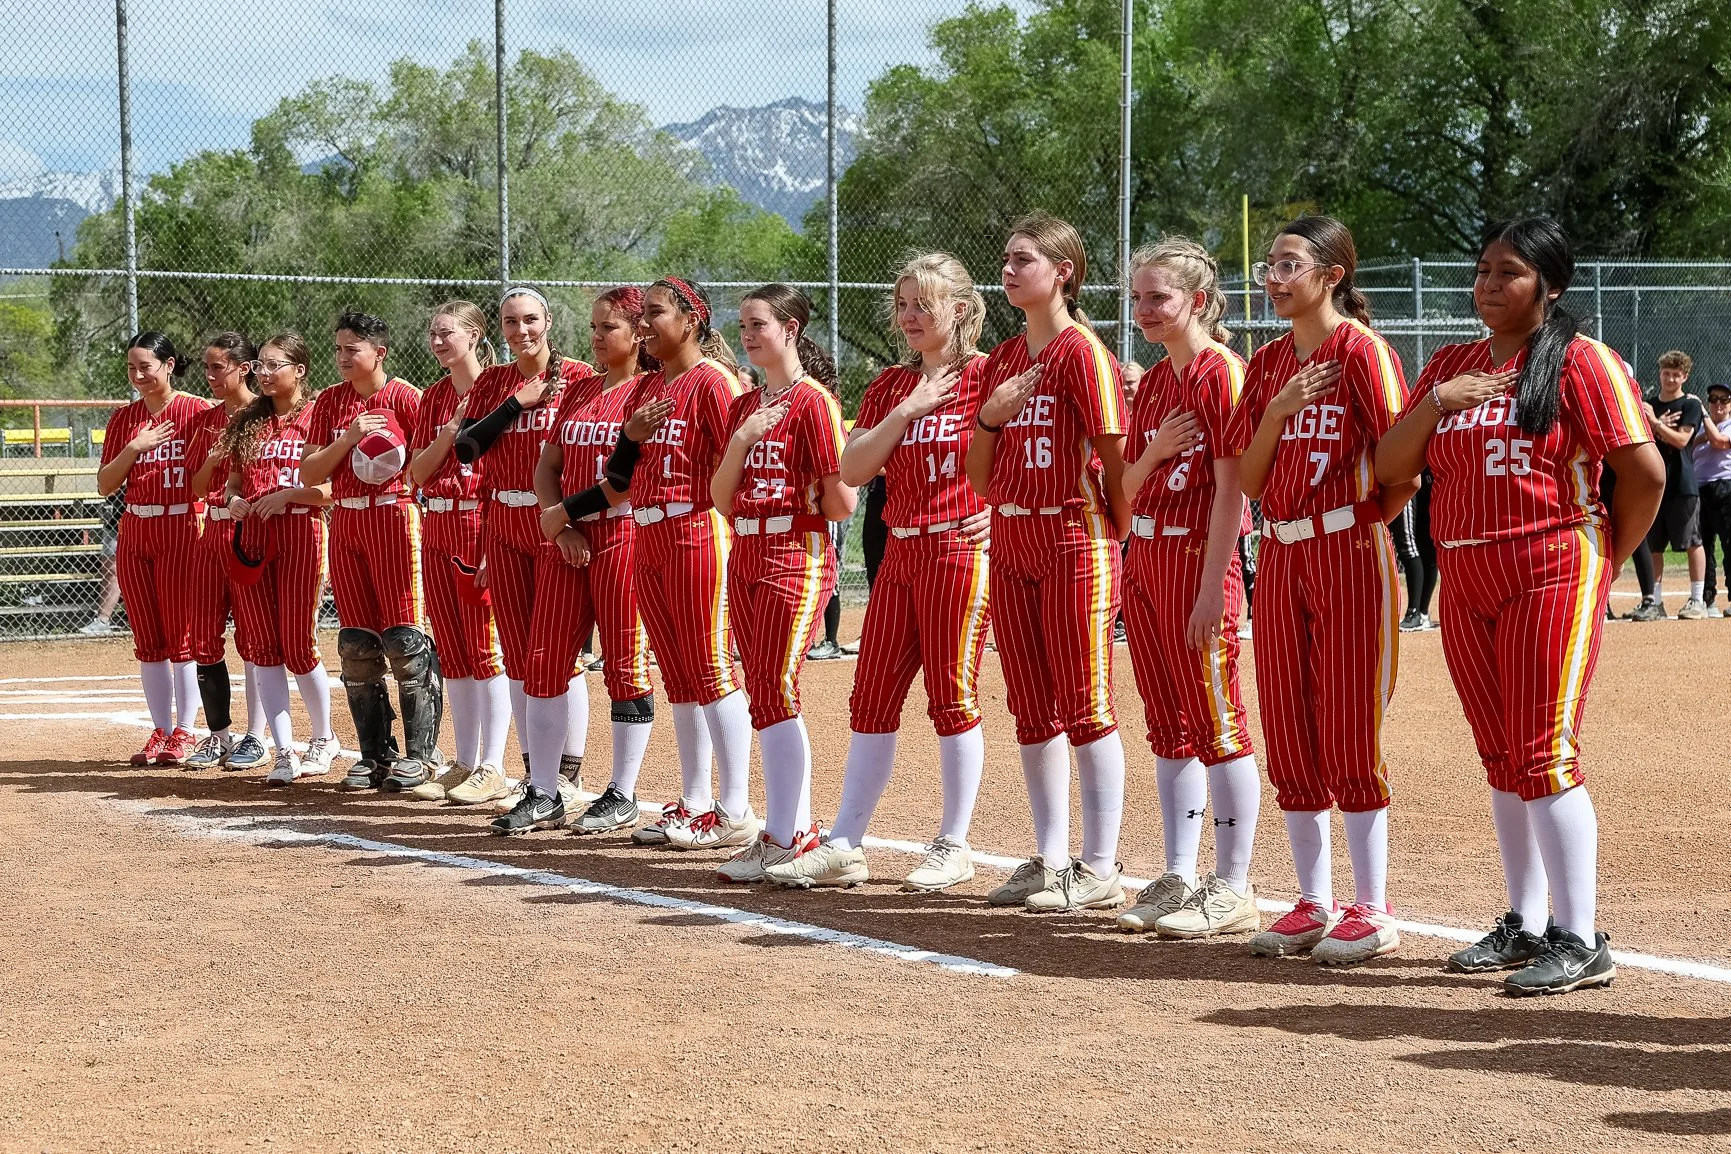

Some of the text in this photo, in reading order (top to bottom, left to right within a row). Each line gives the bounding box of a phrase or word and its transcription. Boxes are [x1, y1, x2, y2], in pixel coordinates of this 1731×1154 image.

[503, 408, 559, 433] DGE
[561, 420, 622, 446] UDGE
[136, 440, 185, 464] DGE
[261, 440, 305, 460] DGE
[1024, 436, 1052, 468] 16
[1485, 438, 1533, 476] 25
[163, 467, 185, 488] 17
[595, 454, 605, 480] 1
[663, 454, 672, 478] 1
[925, 451, 956, 482] 14
[1167, 462, 1190, 491] 6
[1309, 451, 1329, 486] 7
[752, 477, 786, 499] 27
